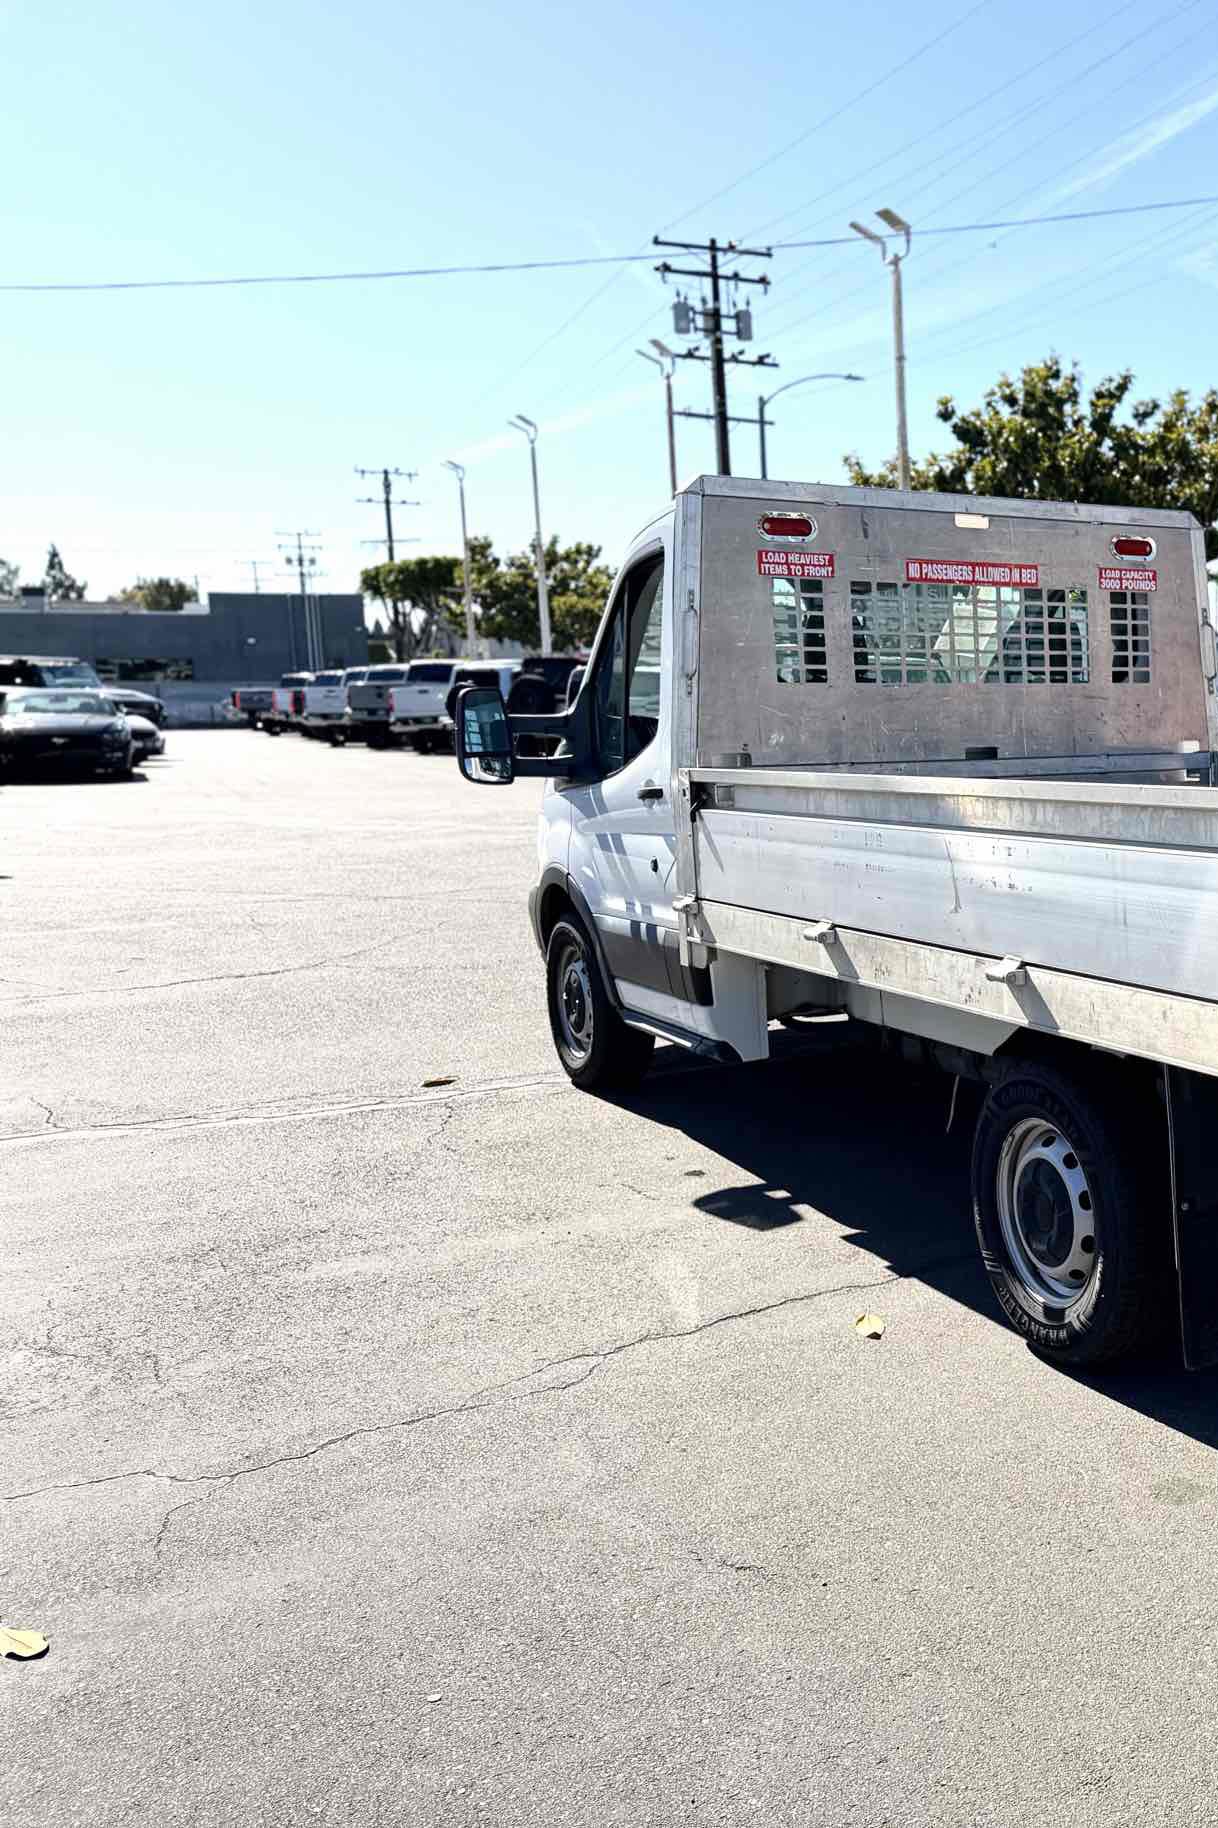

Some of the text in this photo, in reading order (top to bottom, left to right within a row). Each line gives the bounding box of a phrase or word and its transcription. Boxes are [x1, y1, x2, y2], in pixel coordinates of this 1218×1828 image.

[762, 551, 830, 566] LOAD HEAVIEST
[760, 563, 833, 578] ITEMS TO FRONT
[908, 563, 1037, 584] NO PASSENGERS ALLOWED IN BED
[1102, 569, 1154, 580] LOAD CAPACITY
[1100, 578, 1157, 592] 3000 POUNDS
